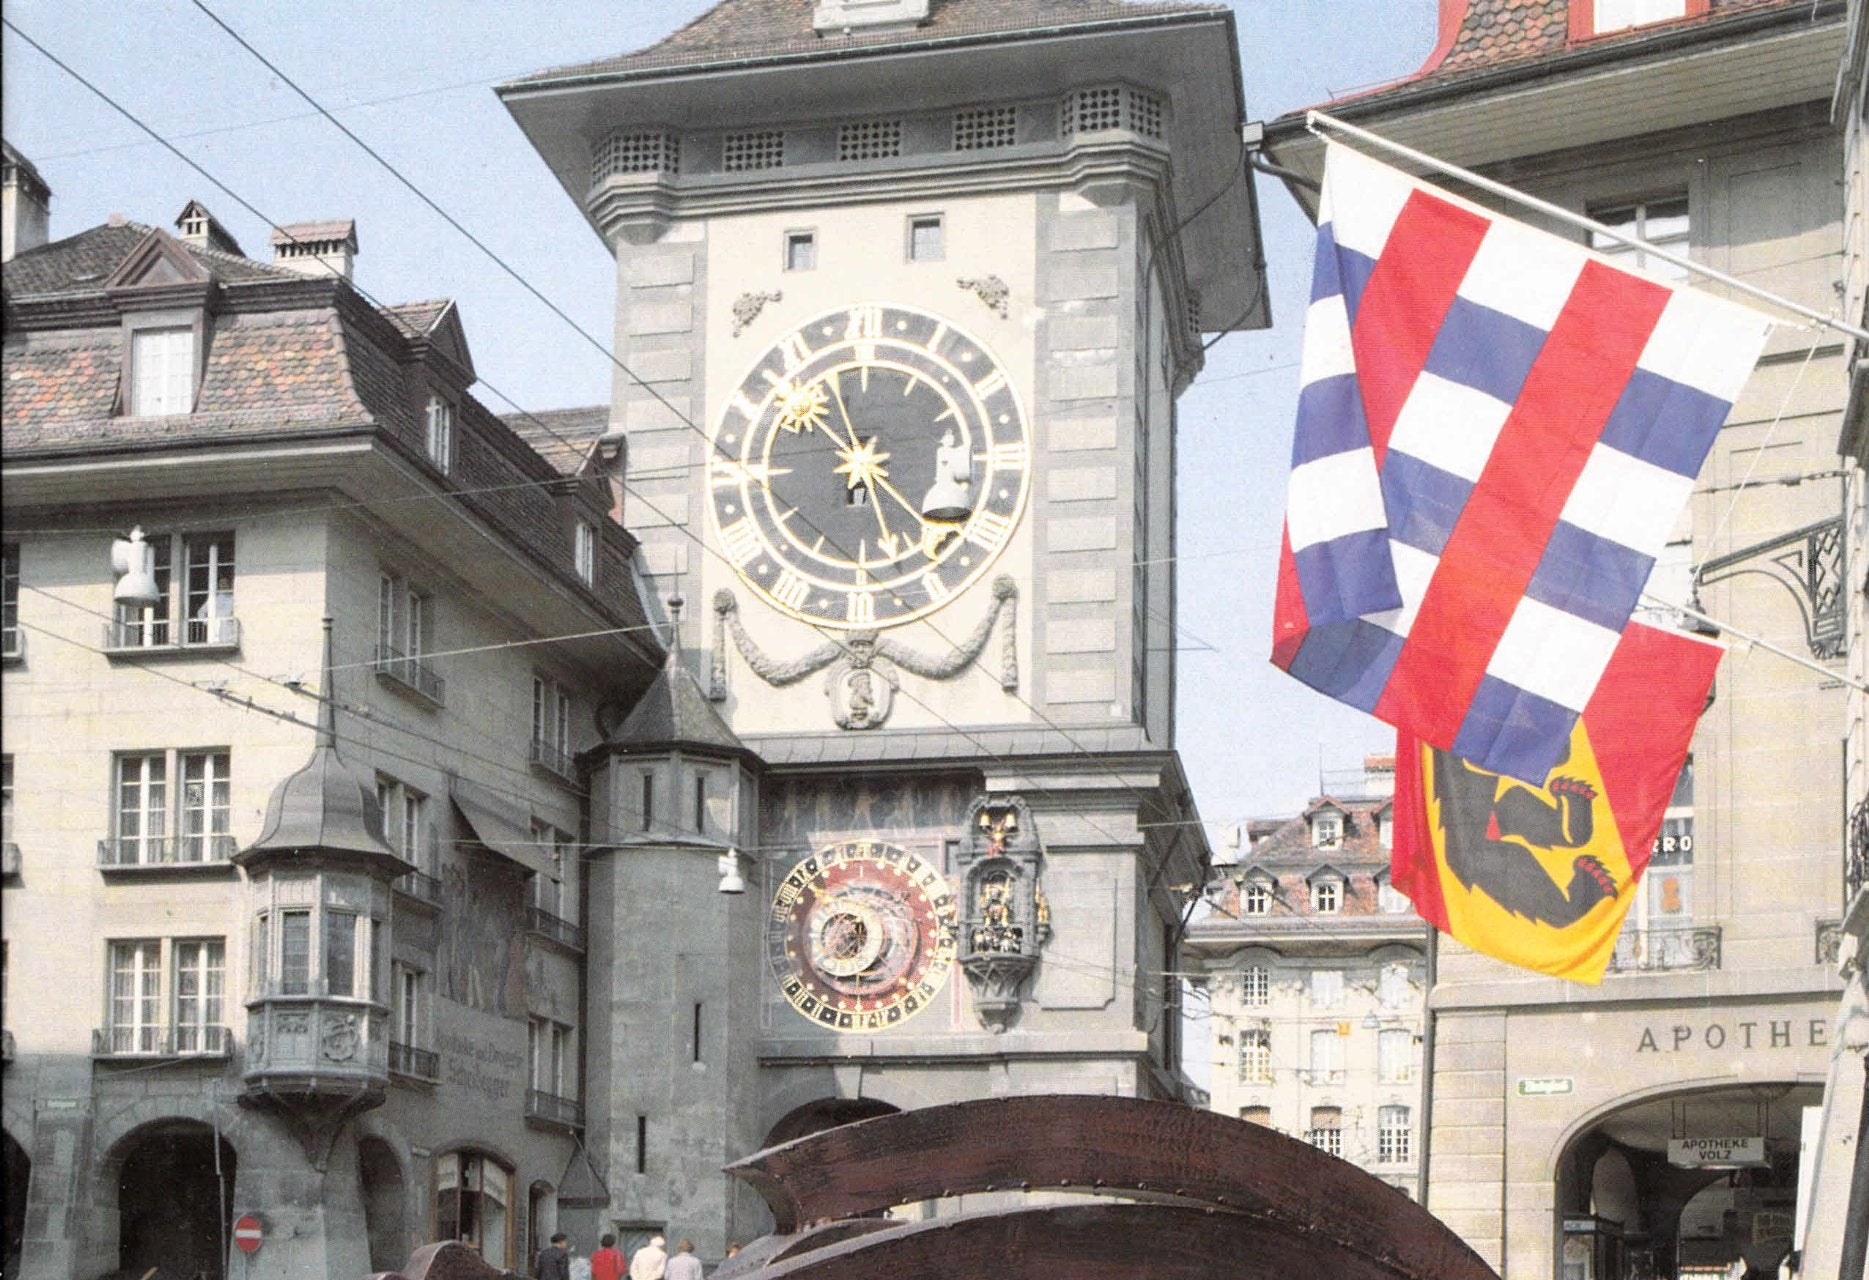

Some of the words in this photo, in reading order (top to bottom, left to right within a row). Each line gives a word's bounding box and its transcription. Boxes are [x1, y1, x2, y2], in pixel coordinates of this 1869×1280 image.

[1637, 1020, 1828, 1052] APOTHE
[1681, 1138, 1749, 1150] APOTHEKE
[1700, 1150, 1732, 1161] VOLZ
